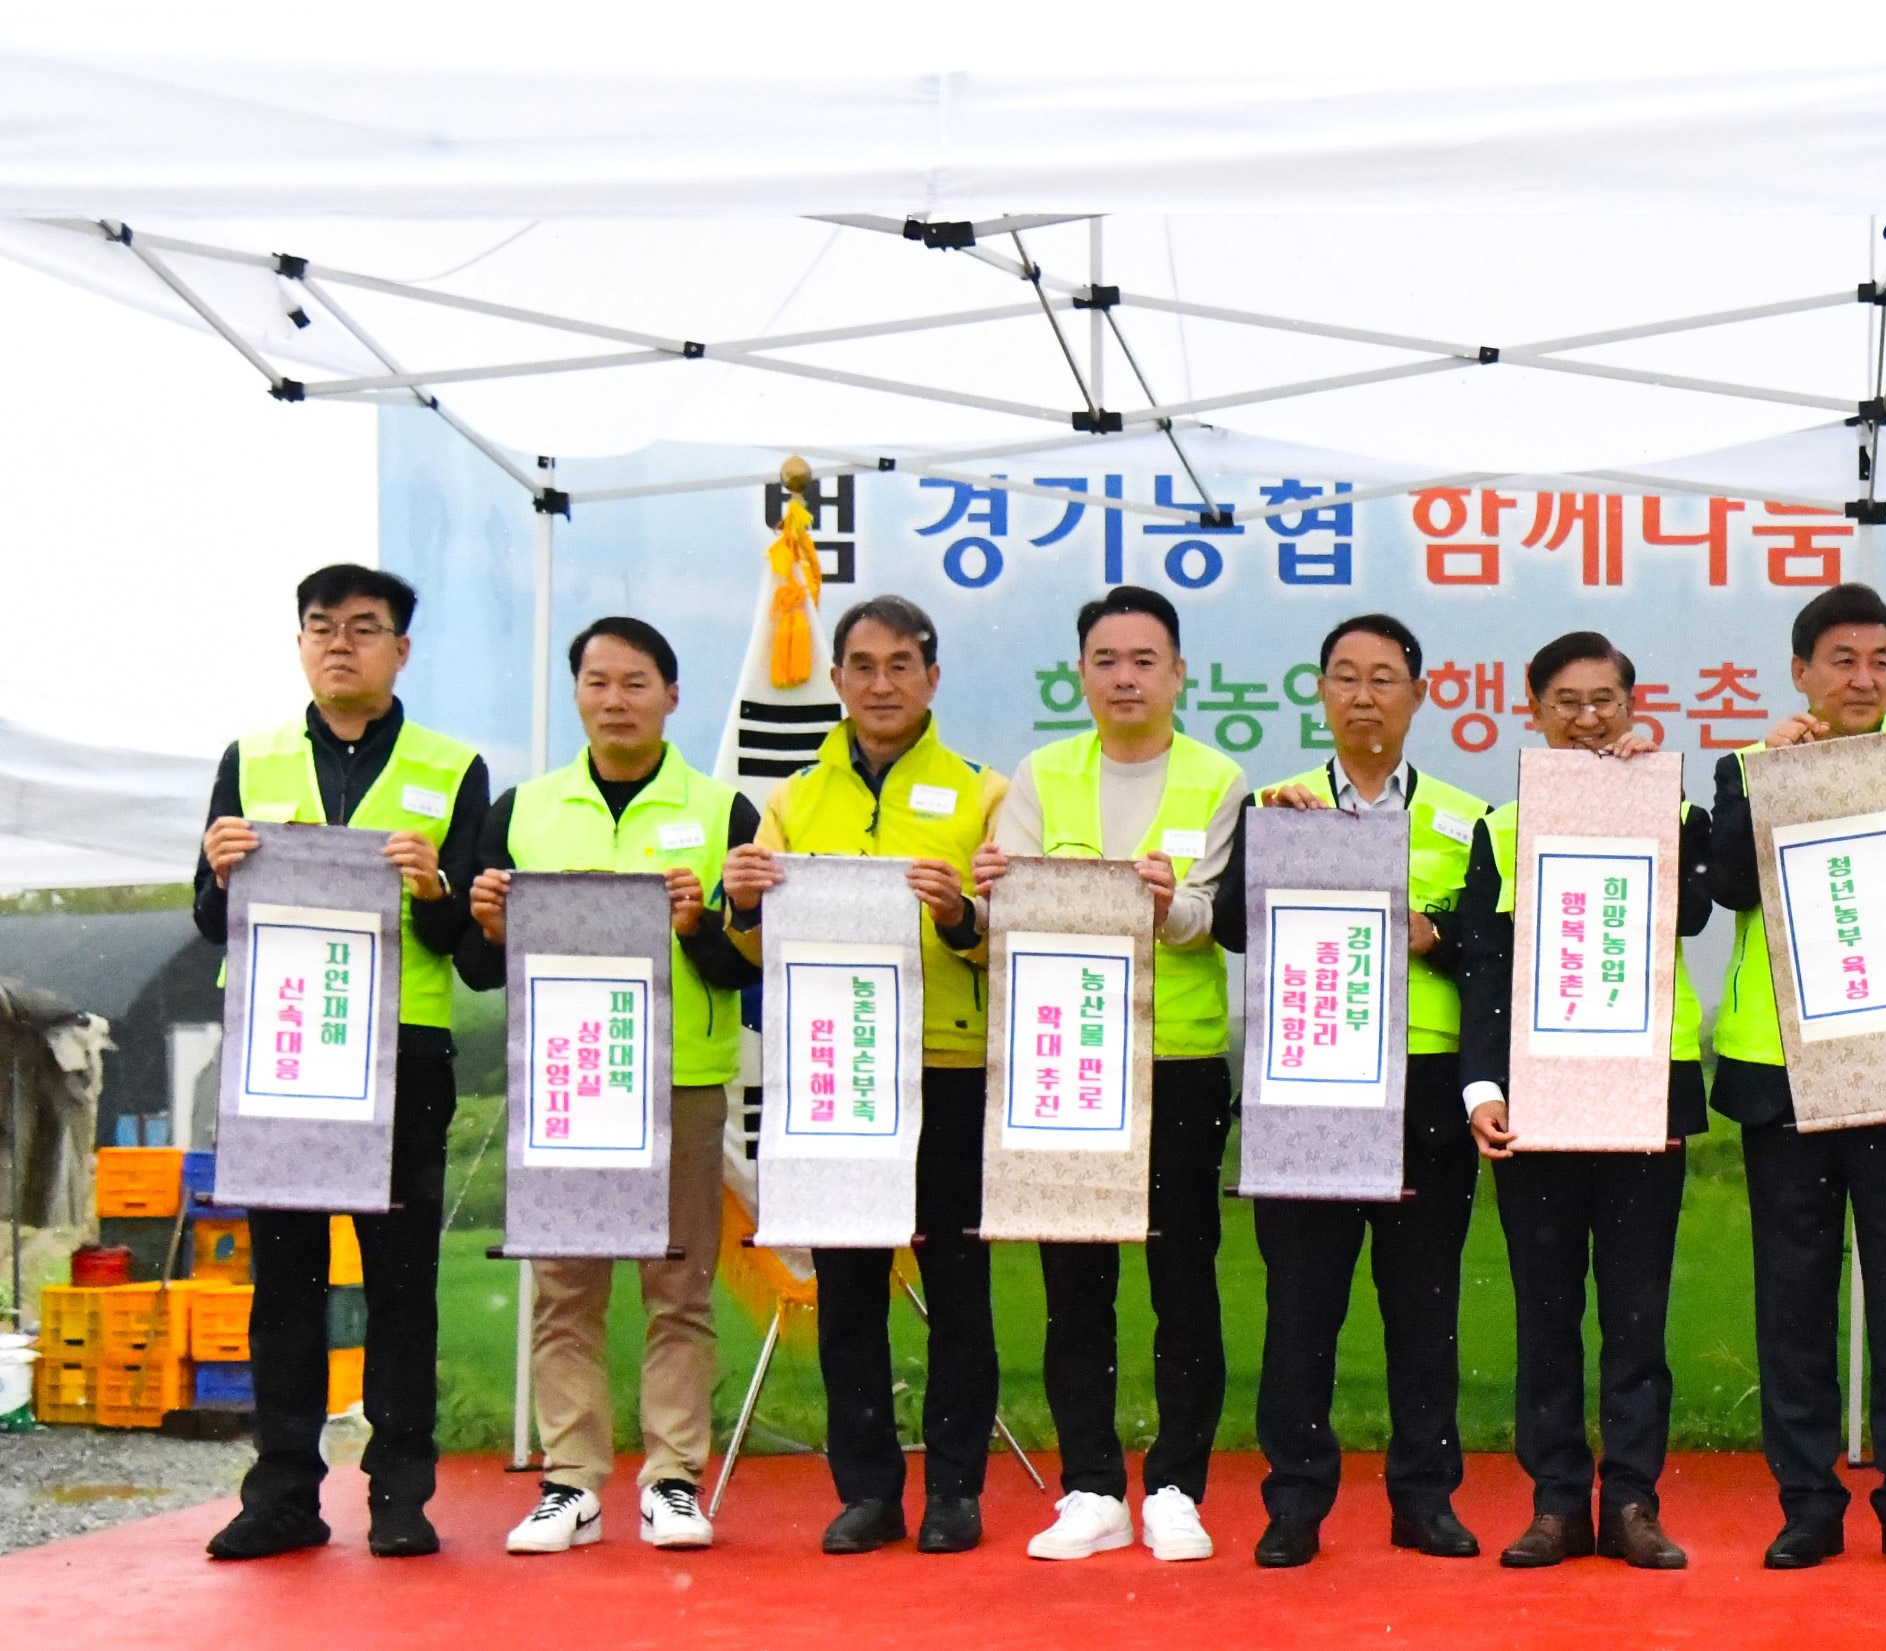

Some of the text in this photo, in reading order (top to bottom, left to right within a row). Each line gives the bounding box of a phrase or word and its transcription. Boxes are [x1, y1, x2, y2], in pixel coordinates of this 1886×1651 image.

[914, 474, 1353, 589] 경기농협
[1408, 487, 1855, 587] 함께나눔
[1033, 661, 1337, 752] 희농업
[1426, 661, 1769, 753] 행촌
[1346, 927, 1372, 1031] 경기본부
[1560, 891, 1587, 1021] 행복농촌!
[1601, 877, 1628, 1007] 희망농업!
[1826, 854, 1869, 1000] 청년농부 육성
[275, 977, 305, 1080] 신속대응
[321, 943, 350, 1045] 자연재해
[609, 991, 635, 1093] 재해대책
[1078, 967, 1105, 1110] 농산물 판로
[1281, 963, 1307, 1067] 능력향상
[1313, 941, 1339, 1046] 종합관리
[545, 1037, 570, 1138] 운영지원
[577, 1021, 602, 1097] 상황실
[810, 1019, 836, 1122] 완벽해결
[851, 975, 876, 1122] 농촌일손부족
[1035, 1005, 1062, 1117] 확대 추진
